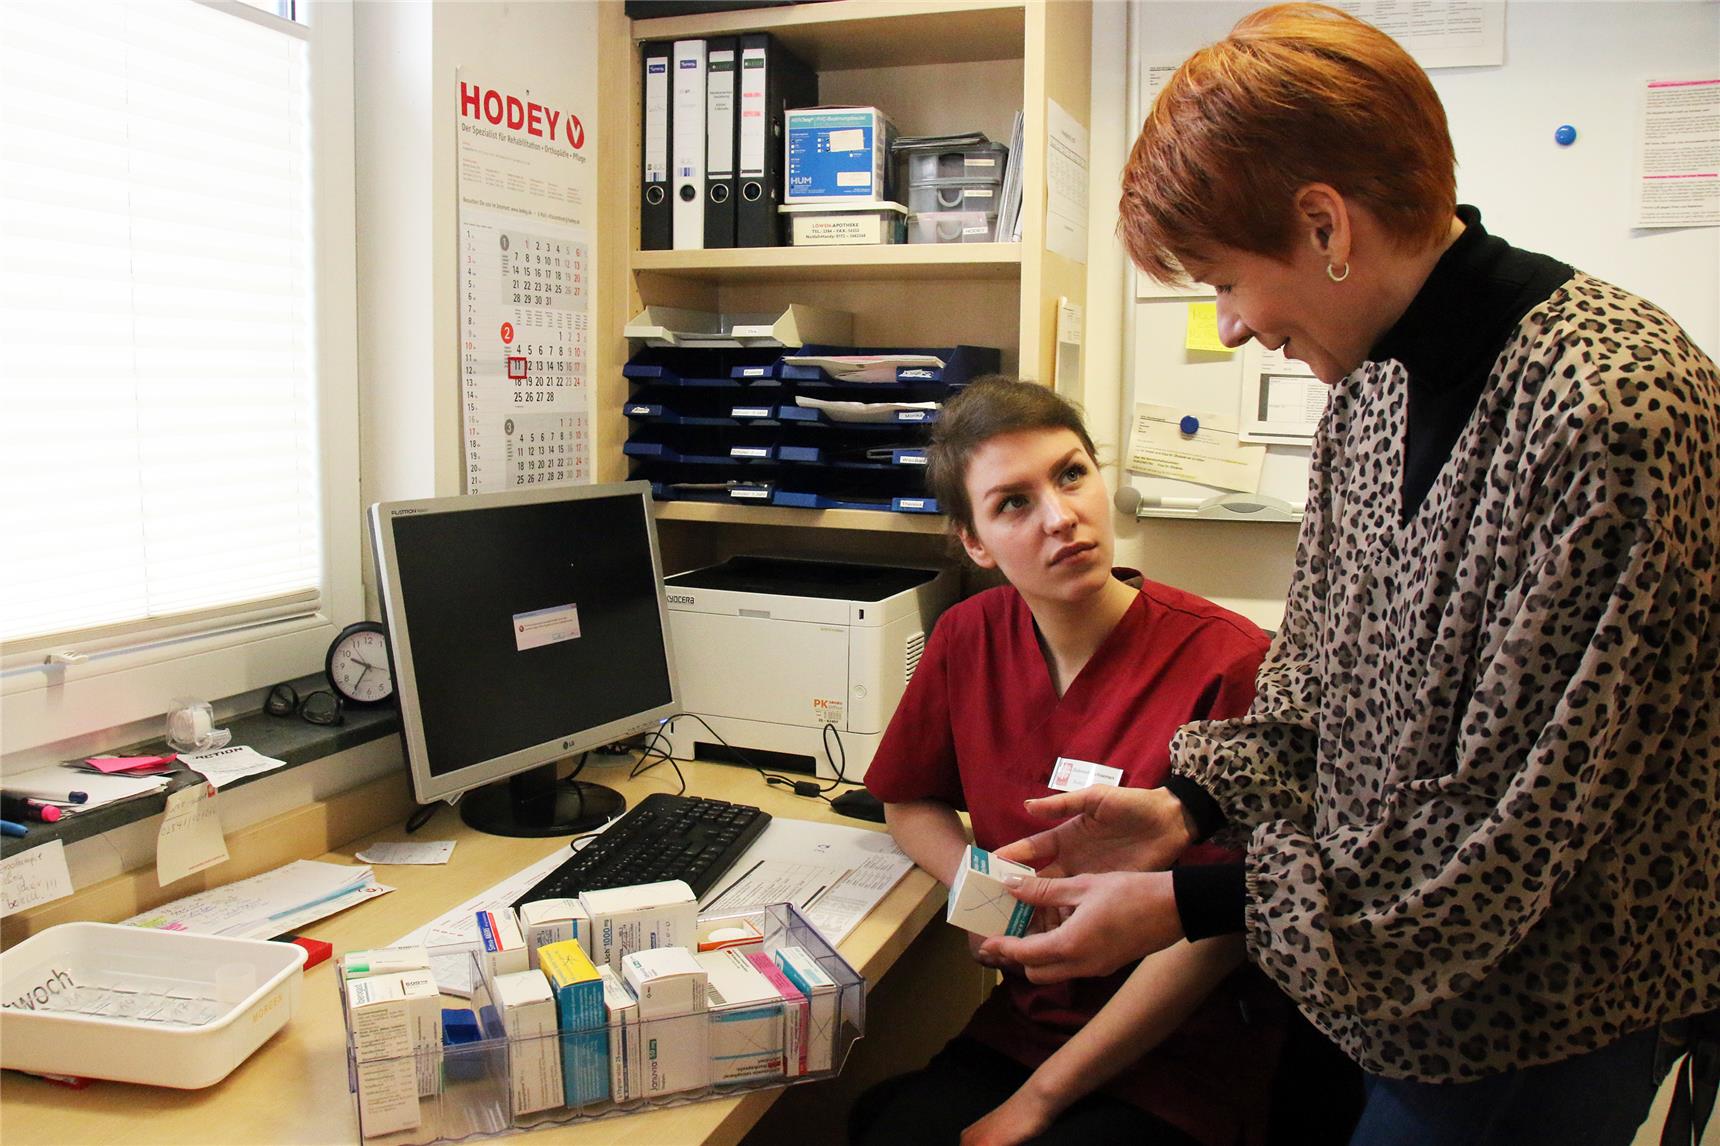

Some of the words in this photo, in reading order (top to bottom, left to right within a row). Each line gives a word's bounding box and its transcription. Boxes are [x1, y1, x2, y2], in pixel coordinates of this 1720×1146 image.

[461, 81, 560, 141] HODEY
[462, 123, 471, 131] Der
[472, 126, 498, 140] Spezialist
[507, 134, 541, 150] Rehabilitation
[573, 153, 586, 164] Pflege
[525, 240, 529, 249] 1
[536, 242, 540, 250] 2
[546, 243, 551, 252] 3
[556, 245, 560, 254] 4
[576, 249, 581, 257] 6
[468, 256, 472, 264] 3
[515, 252, 519, 261] 7
[526, 253, 530, 263] 8
[537, 255, 541, 264] 9
[545, 257, 551, 266] 10
[555, 258, 560, 267] 11
[513, 265, 519, 274] 14
[524, 267, 530, 276] 15
[535, 268, 541, 278] 16
[545, 270, 551, 278] 17
[555, 271, 561, 280] 18
[468, 280, 472, 288] 5
[513, 280, 519, 289] 21
[524, 281, 531, 290] 22
[534, 282, 541, 292] 23
[545, 284, 552, 292] 24
[555, 285, 562, 294] 25
[574, 287, 580, 296] 27
[513, 293, 520, 303] 28
[524, 294, 531, 304] 29
[535, 296, 542, 304] 30
[546, 297, 552, 306] 31
[468, 305, 472, 313] 7
[468, 317, 472, 325] 8
[504, 327, 510, 339] 2
[559, 331, 562, 341] 1
[466, 342, 472, 351] 10
[517, 345, 521, 354] 4
[528, 345, 532, 355] 5
[539, 345, 543, 355] 6
[549, 346, 553, 355] 7
[559, 346, 563, 356] 8
[575, 347, 580, 357] 10
[465, 354, 472, 362] 11
[466, 366, 473, 375] 12
[514, 360, 521, 371] 11
[527, 361, 532, 371] 2
[536, 361, 543, 371] 13
[547, 361, 554, 371] 14
[557, 362, 564, 372] 15
[466, 379, 473, 387] 13
[536, 377, 544, 387] 20
[546, 377, 553, 386] 21
[556, 377, 563, 387] 22
[574, 377, 580, 387] 24
[467, 391, 474, 399] 14
[514, 392, 523, 402] 25
[525, 392, 534, 402] 26
[536, 392, 544, 402] 27
[546, 392, 554, 402] 28
[467, 403, 475, 411] 15
[560, 418, 563, 427] 1
[469, 428, 476, 436] 17
[520, 434, 524, 442] 4
[530, 433, 534, 442] 5
[541, 432, 545, 442] 6
[551, 432, 554, 441] 7
[560, 432, 564, 441] 8
[576, 431, 582, 440] 10
[469, 440, 476, 448] 18
[517, 448, 523, 457] 11
[528, 447, 535, 456] 12
[538, 446, 545, 455] 13
[548, 445, 555, 454] 14
[558, 444, 564, 453] 15
[576, 443, 582, 452] 17
[470, 452, 477, 460] 19
[517, 461, 524, 471] 18
[528, 460, 535, 470] 19
[538, 460, 545, 469] 20
[548, 459, 554, 468] 21
[557, 458, 564, 467] 22
[471, 477, 478, 485] 21
[517, 475, 525, 484] 25
[527, 474, 535, 484] 26
[538, 473, 545, 482] 27
[547, 471, 554, 481] 28
[557, 471, 564, 480] 29
[364, 637, 373, 645] 12
[342, 650, 351, 658] 10
[379, 683, 384, 691] 5
[814, 699, 828, 708] PK
[602, 927, 611, 947] 1000
[1, 969, 74, 1011] woch
[650, 1061, 658, 1091] Januvia
